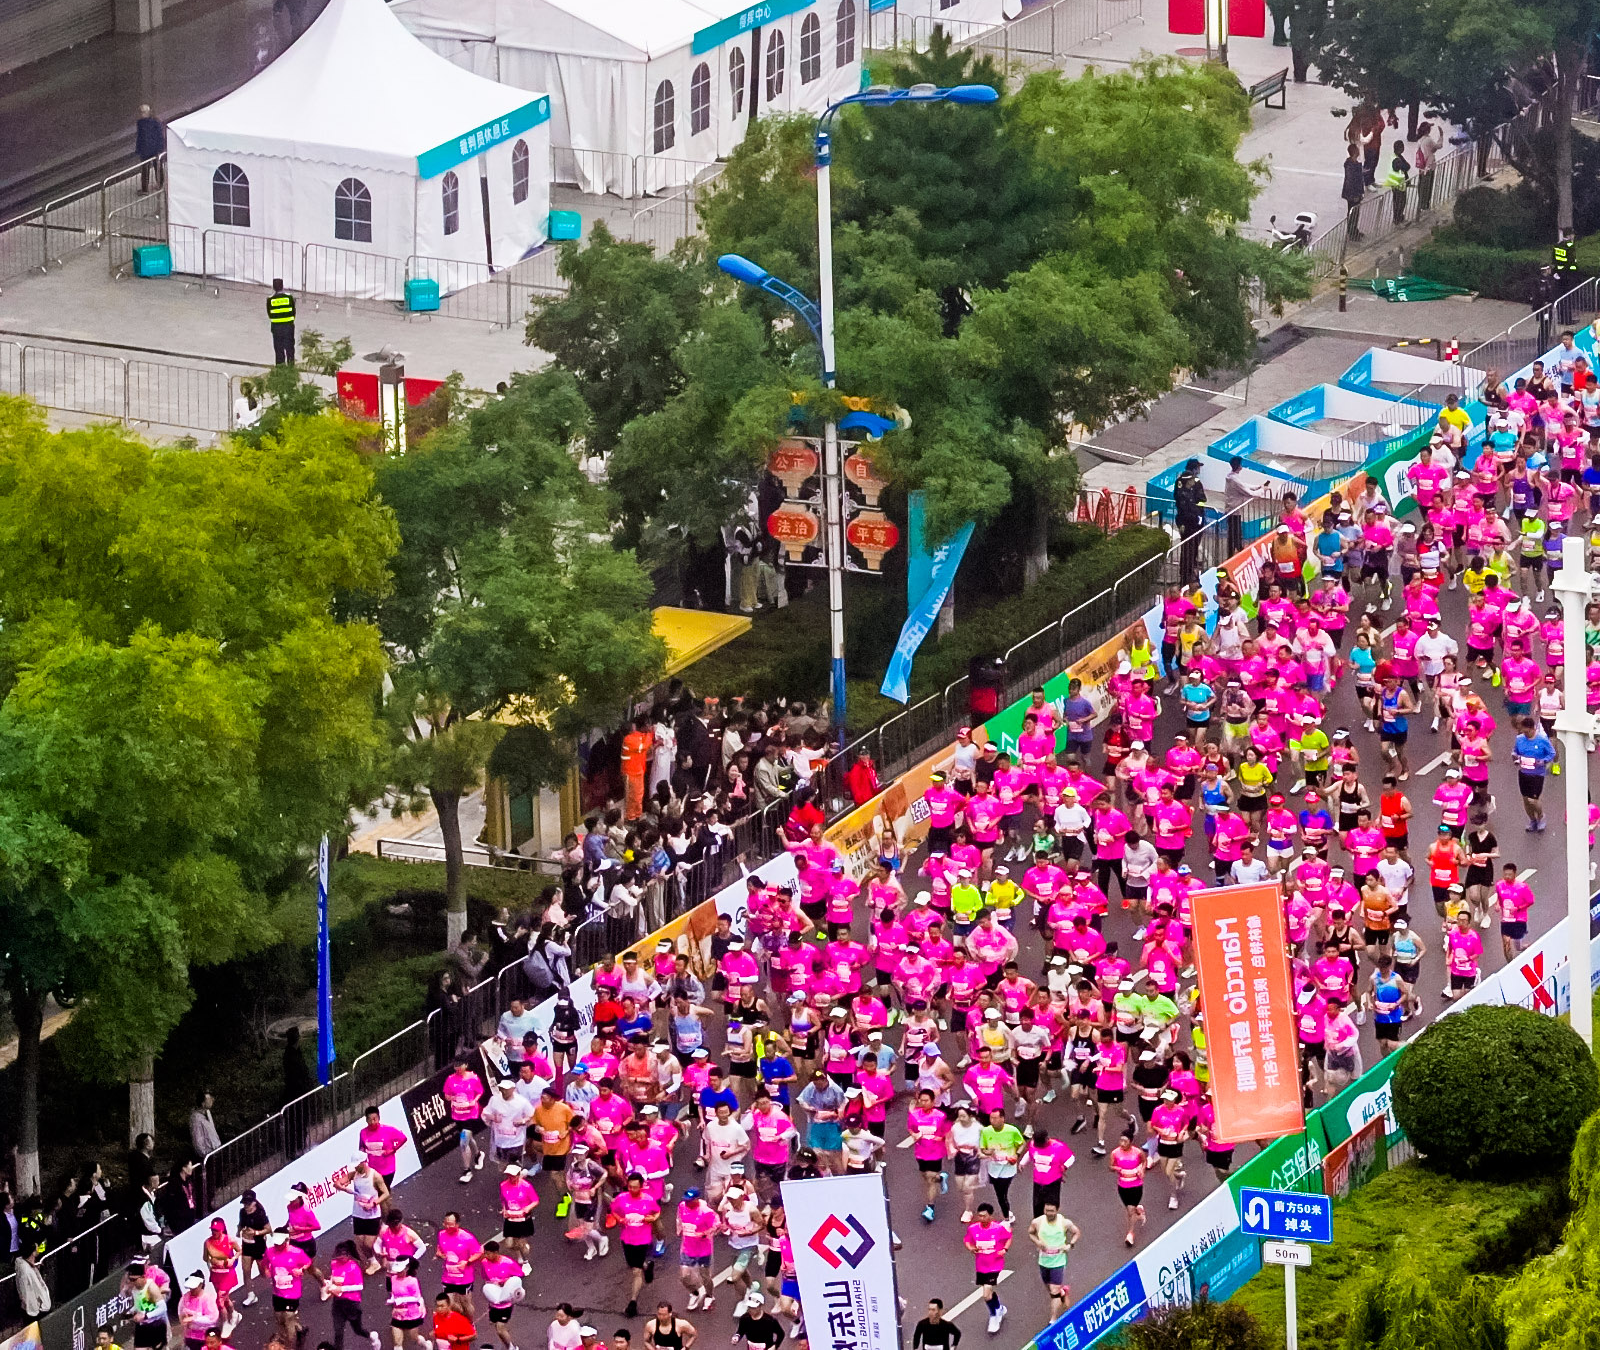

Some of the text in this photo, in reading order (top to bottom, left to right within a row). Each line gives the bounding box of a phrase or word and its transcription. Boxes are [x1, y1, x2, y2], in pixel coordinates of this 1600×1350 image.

[459, 118, 511, 156] 裁判员休息区
[776, 458, 806, 469] 公正
[777, 519, 808, 535] 法治
[857, 527, 887, 544] 平等
[410, 1093, 447, 1134] 真年份
[1274, 1199, 1322, 1216] 前方50米
[1284, 1217, 1312, 1233] 掉头
[1275, 1248, 1300, 1261] 50m
